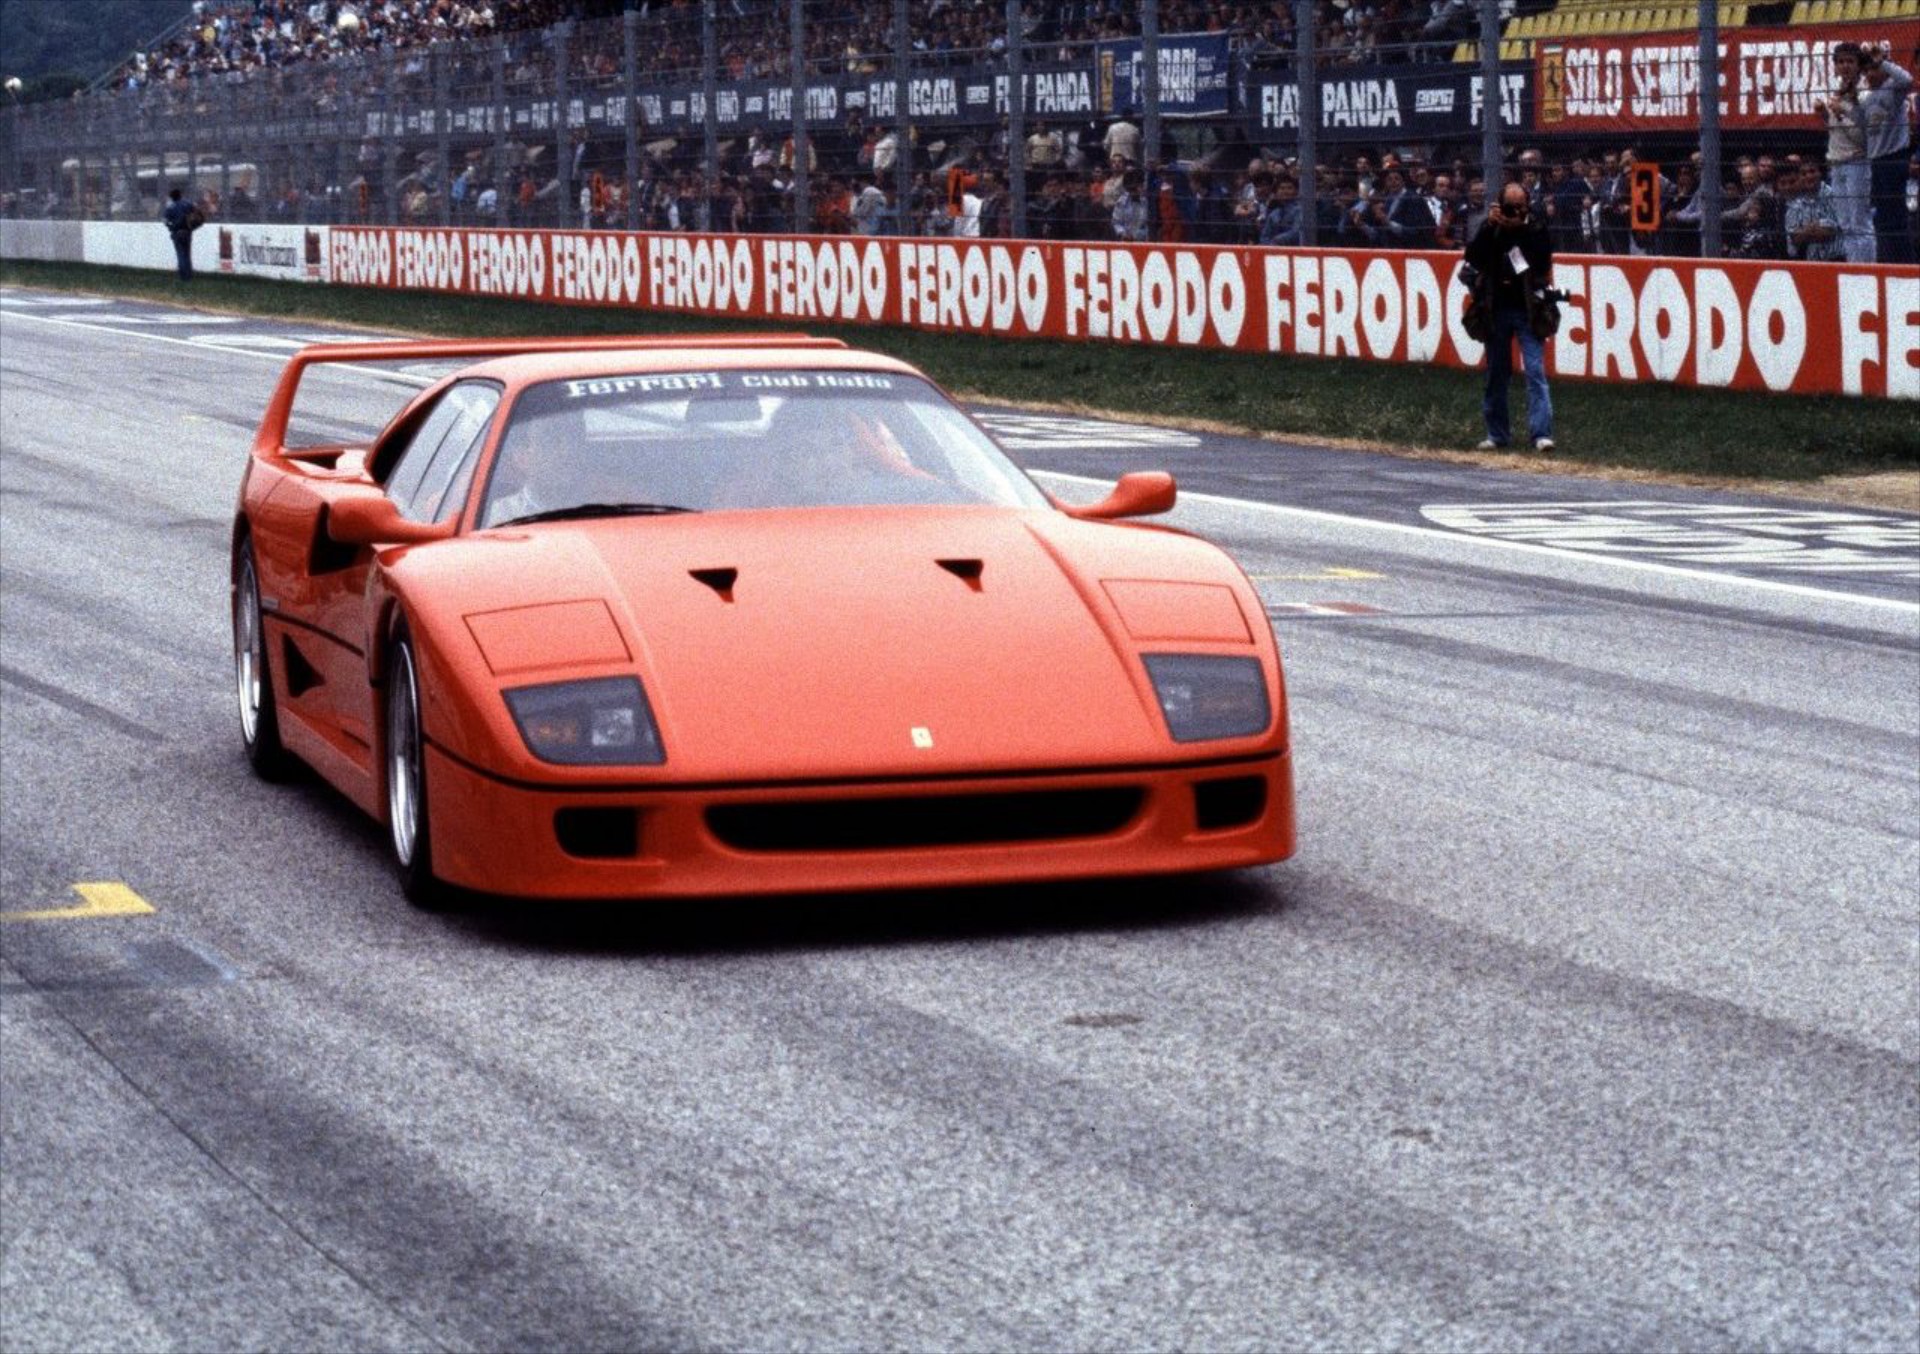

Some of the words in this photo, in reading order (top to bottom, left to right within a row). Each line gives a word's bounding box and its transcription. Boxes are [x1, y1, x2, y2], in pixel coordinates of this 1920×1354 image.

[869, 81, 897, 118] FIAT
[995, 75, 1029, 113] FIT
[1035, 71, 1092, 112] PANDA
[1130, 47, 1197, 105] FRARI
[1470, 74, 1525, 126] FAT
[1565, 47, 1623, 116] SOLO
[1631, 44, 1728, 116] SEMPE
[1738, 40, 1844, 115] FERRAR
[1322, 79, 1401, 127] PANDA
[1636, 169, 1654, 223] 3
[331, 230, 390, 284] FERODO
[396, 231, 464, 290] FERODO
[468, 234, 545, 297] FERODO
[551, 236, 641, 303] FERODO
[648, 237, 754, 311] FERODO
[762, 241, 886, 321] FERODO
[901, 244, 1049, 332] FERODO
[1063, 248, 1246, 347] FERODO
[1553, 264, 1807, 391] ERODO
[564, 371, 722, 398] Ferrari
[741, 374, 809, 388] Club
